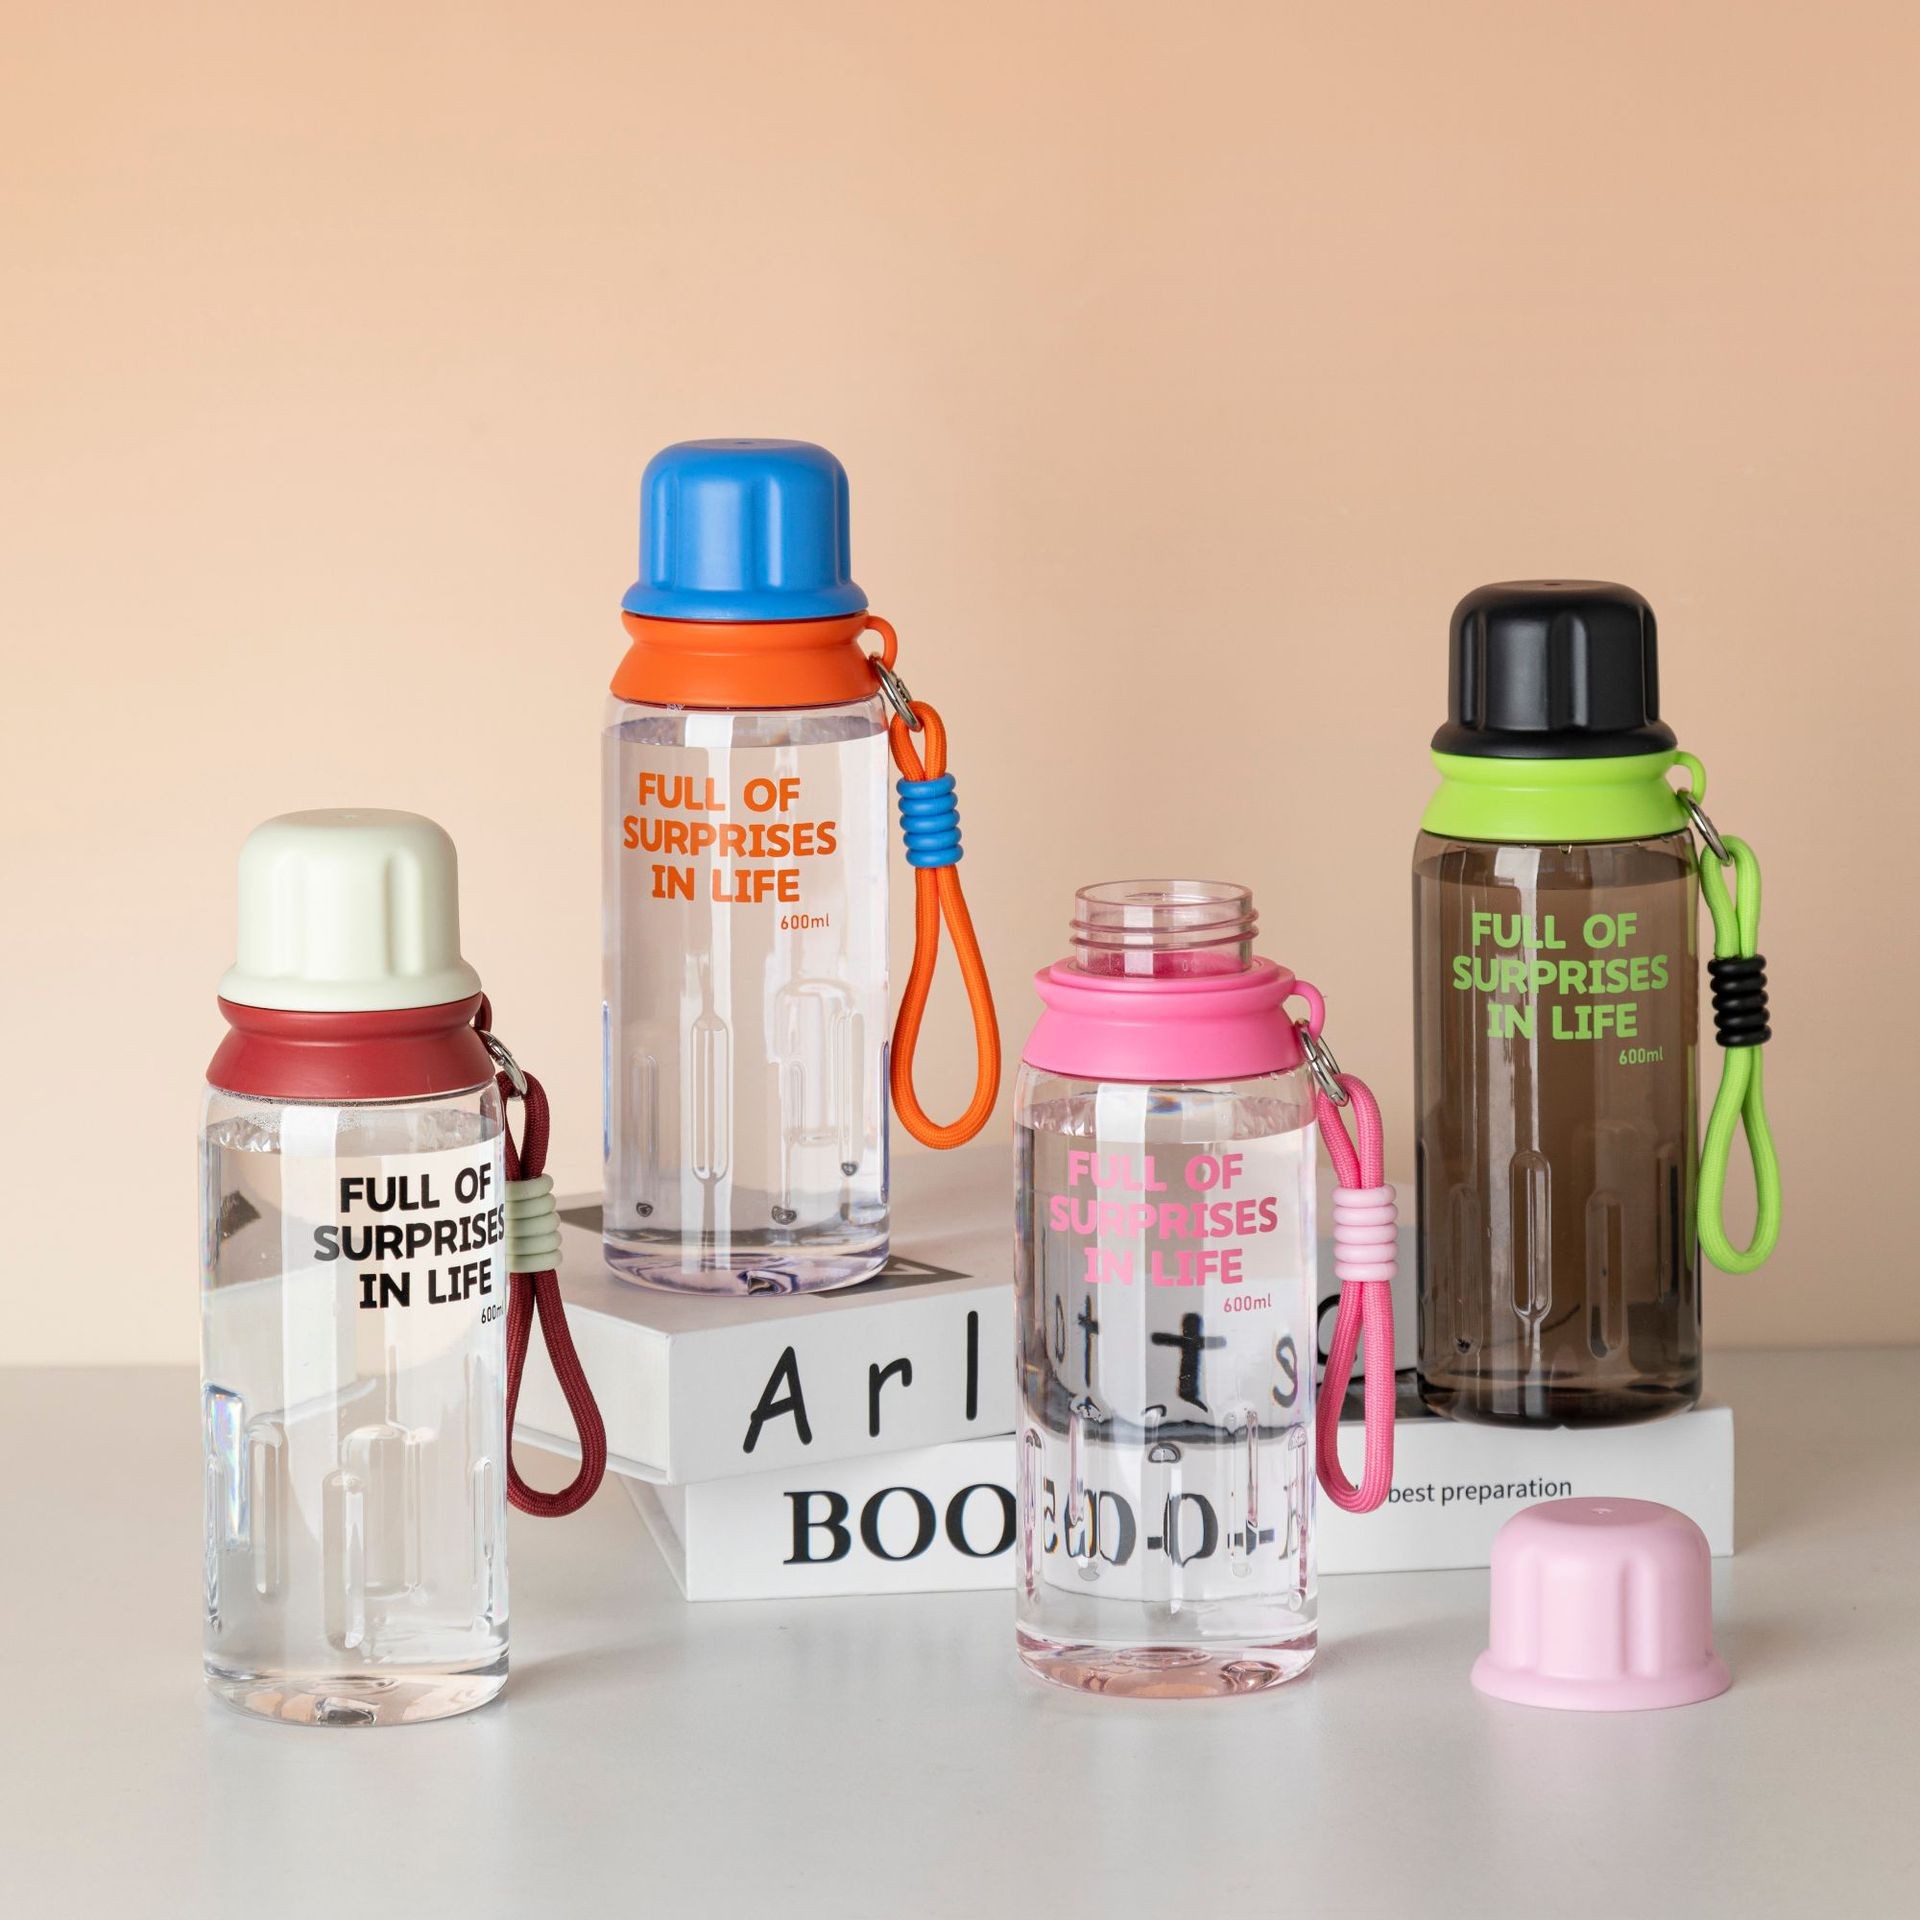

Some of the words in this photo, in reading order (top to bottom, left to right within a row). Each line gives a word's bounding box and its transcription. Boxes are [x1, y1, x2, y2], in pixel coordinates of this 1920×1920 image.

[639, 772, 726, 811] FULL
[743, 777, 801, 812] OF
[623, 815, 837, 857] SURPRISES
[651, 864, 695, 901] IN
[712, 868, 800, 903] LIFE
[780, 913, 830, 930] 600ml
[1471, 912, 1567, 949] FULL
[1582, 912, 1638, 949] OF
[1452, 954, 1669, 995] SURPRISES
[1486, 1003, 1535, 1039] IN
[1552, 1002, 1638, 1040] LIFE
[1618, 1046, 1664, 1065] 600ml
[340, 1173, 440, 1213] FULL
[454, 1162, 492, 1204] OF
[1068, 1150, 1168, 1192] FULL
[1184, 1153, 1243, 1192] OF
[313, 1204, 505, 1262] SURPRISES
[1050, 1196, 1278, 1240] SURPRISES
[359, 1271, 411, 1309] IN
[428, 1257, 492, 1305] LIFE
[1083, 1247, 1134, 1286] IN
[1151, 1248, 1243, 1287] LIFE
[1222, 1293, 1272, 1313] 600ml
[1388, 1483, 1436, 1504] best
[1441, 1477, 1573, 1507] preparation
